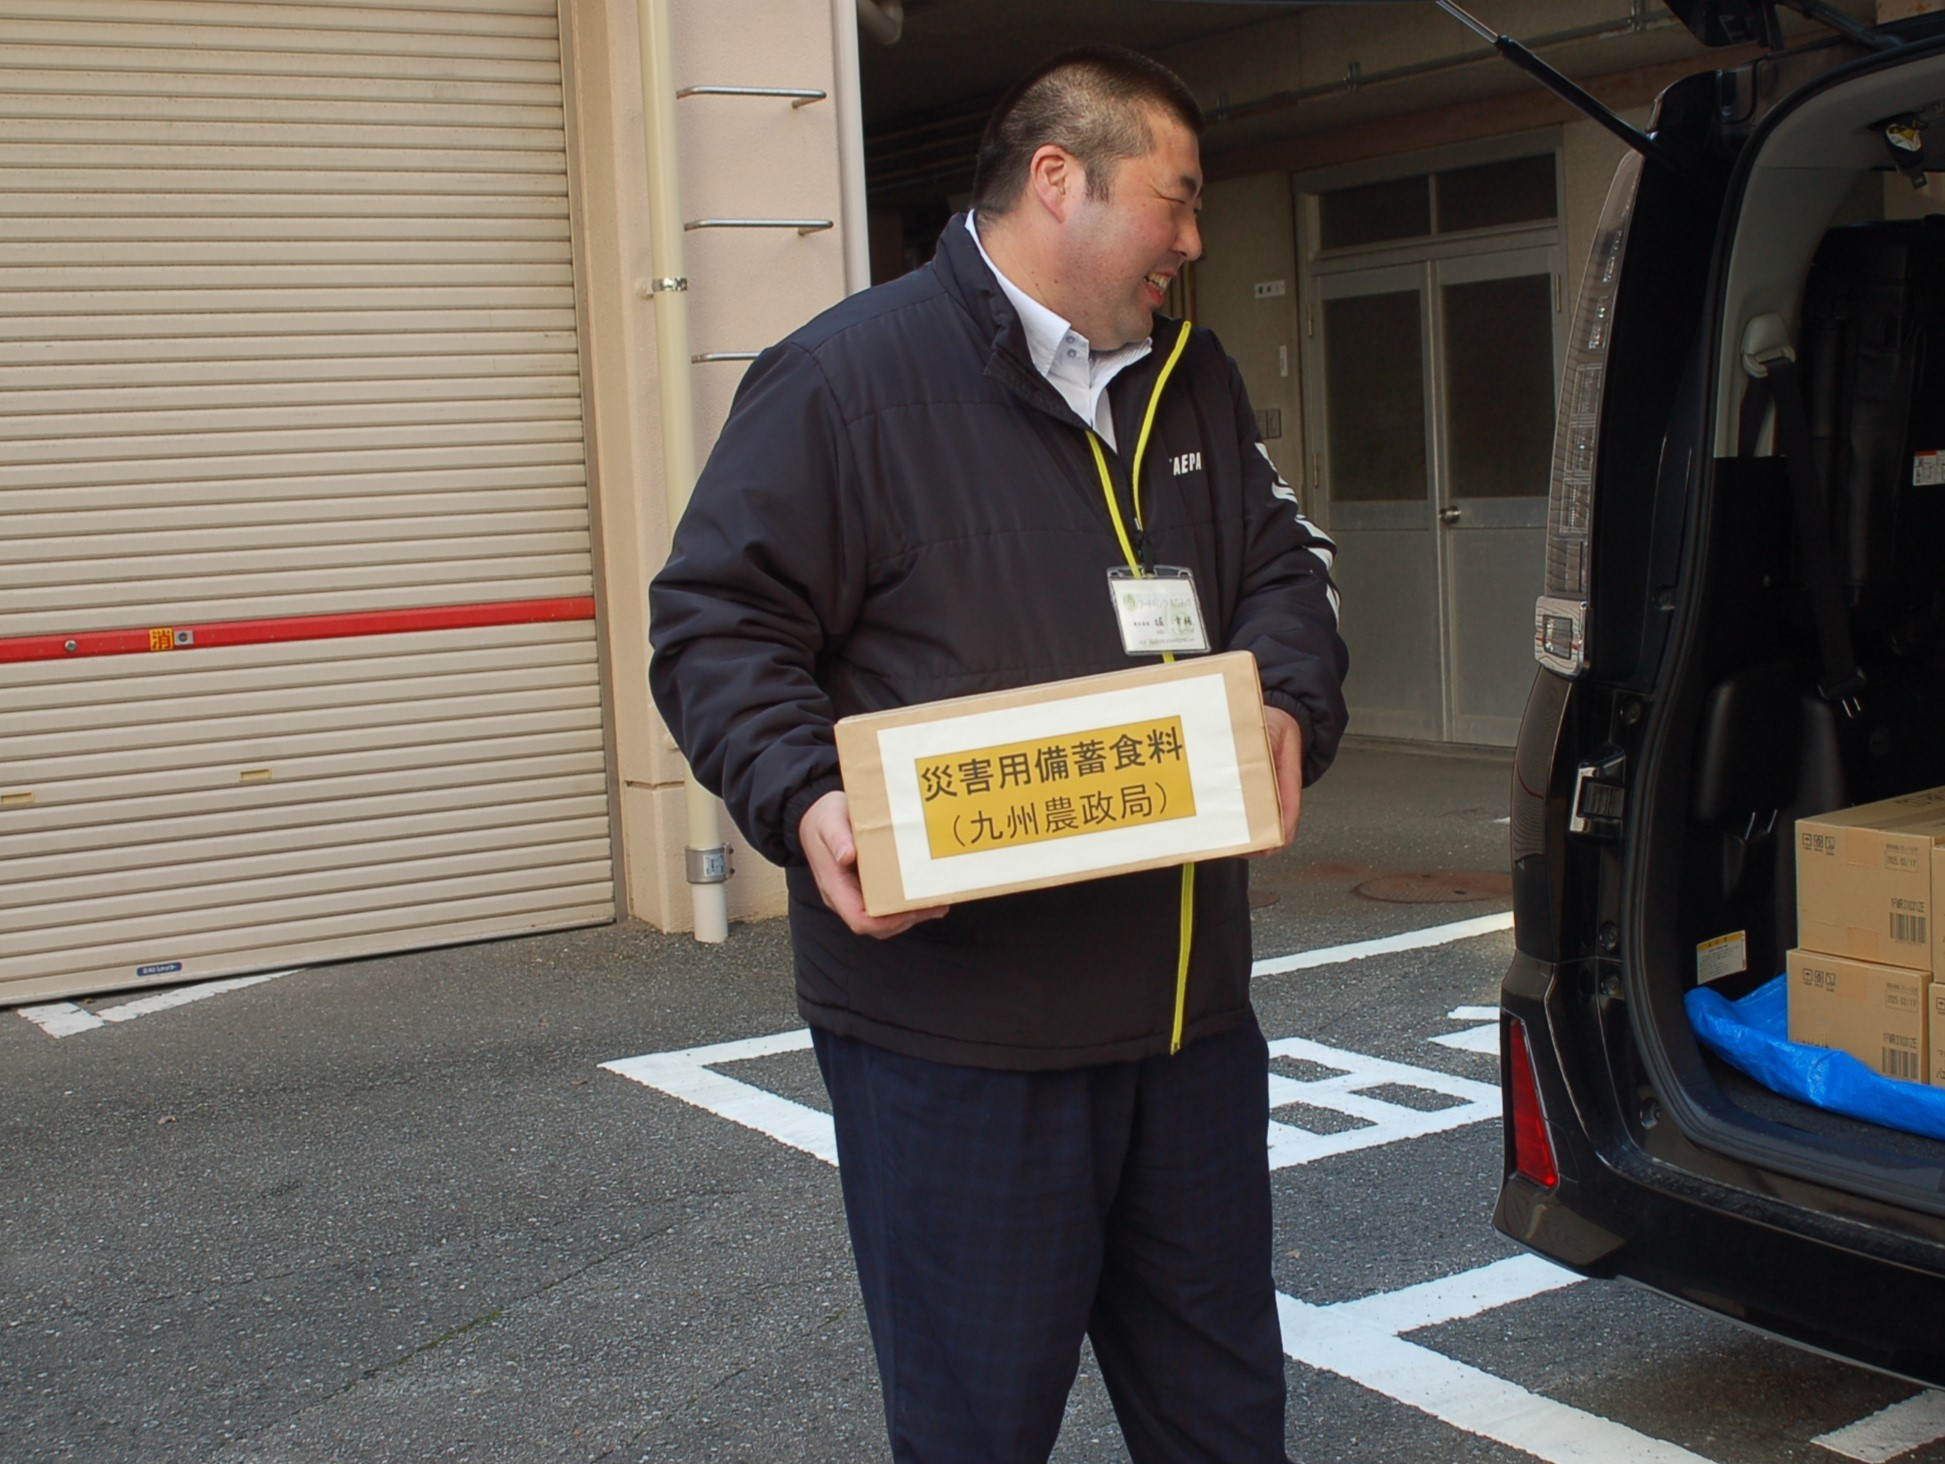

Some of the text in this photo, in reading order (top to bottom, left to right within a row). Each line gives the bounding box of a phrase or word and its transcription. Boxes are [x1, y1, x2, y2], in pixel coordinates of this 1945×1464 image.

[1168, 451, 1202, 476] AEPA
[151, 629, 172, 650] 消
[921, 726, 1183, 802] 災害用備蓄食料
